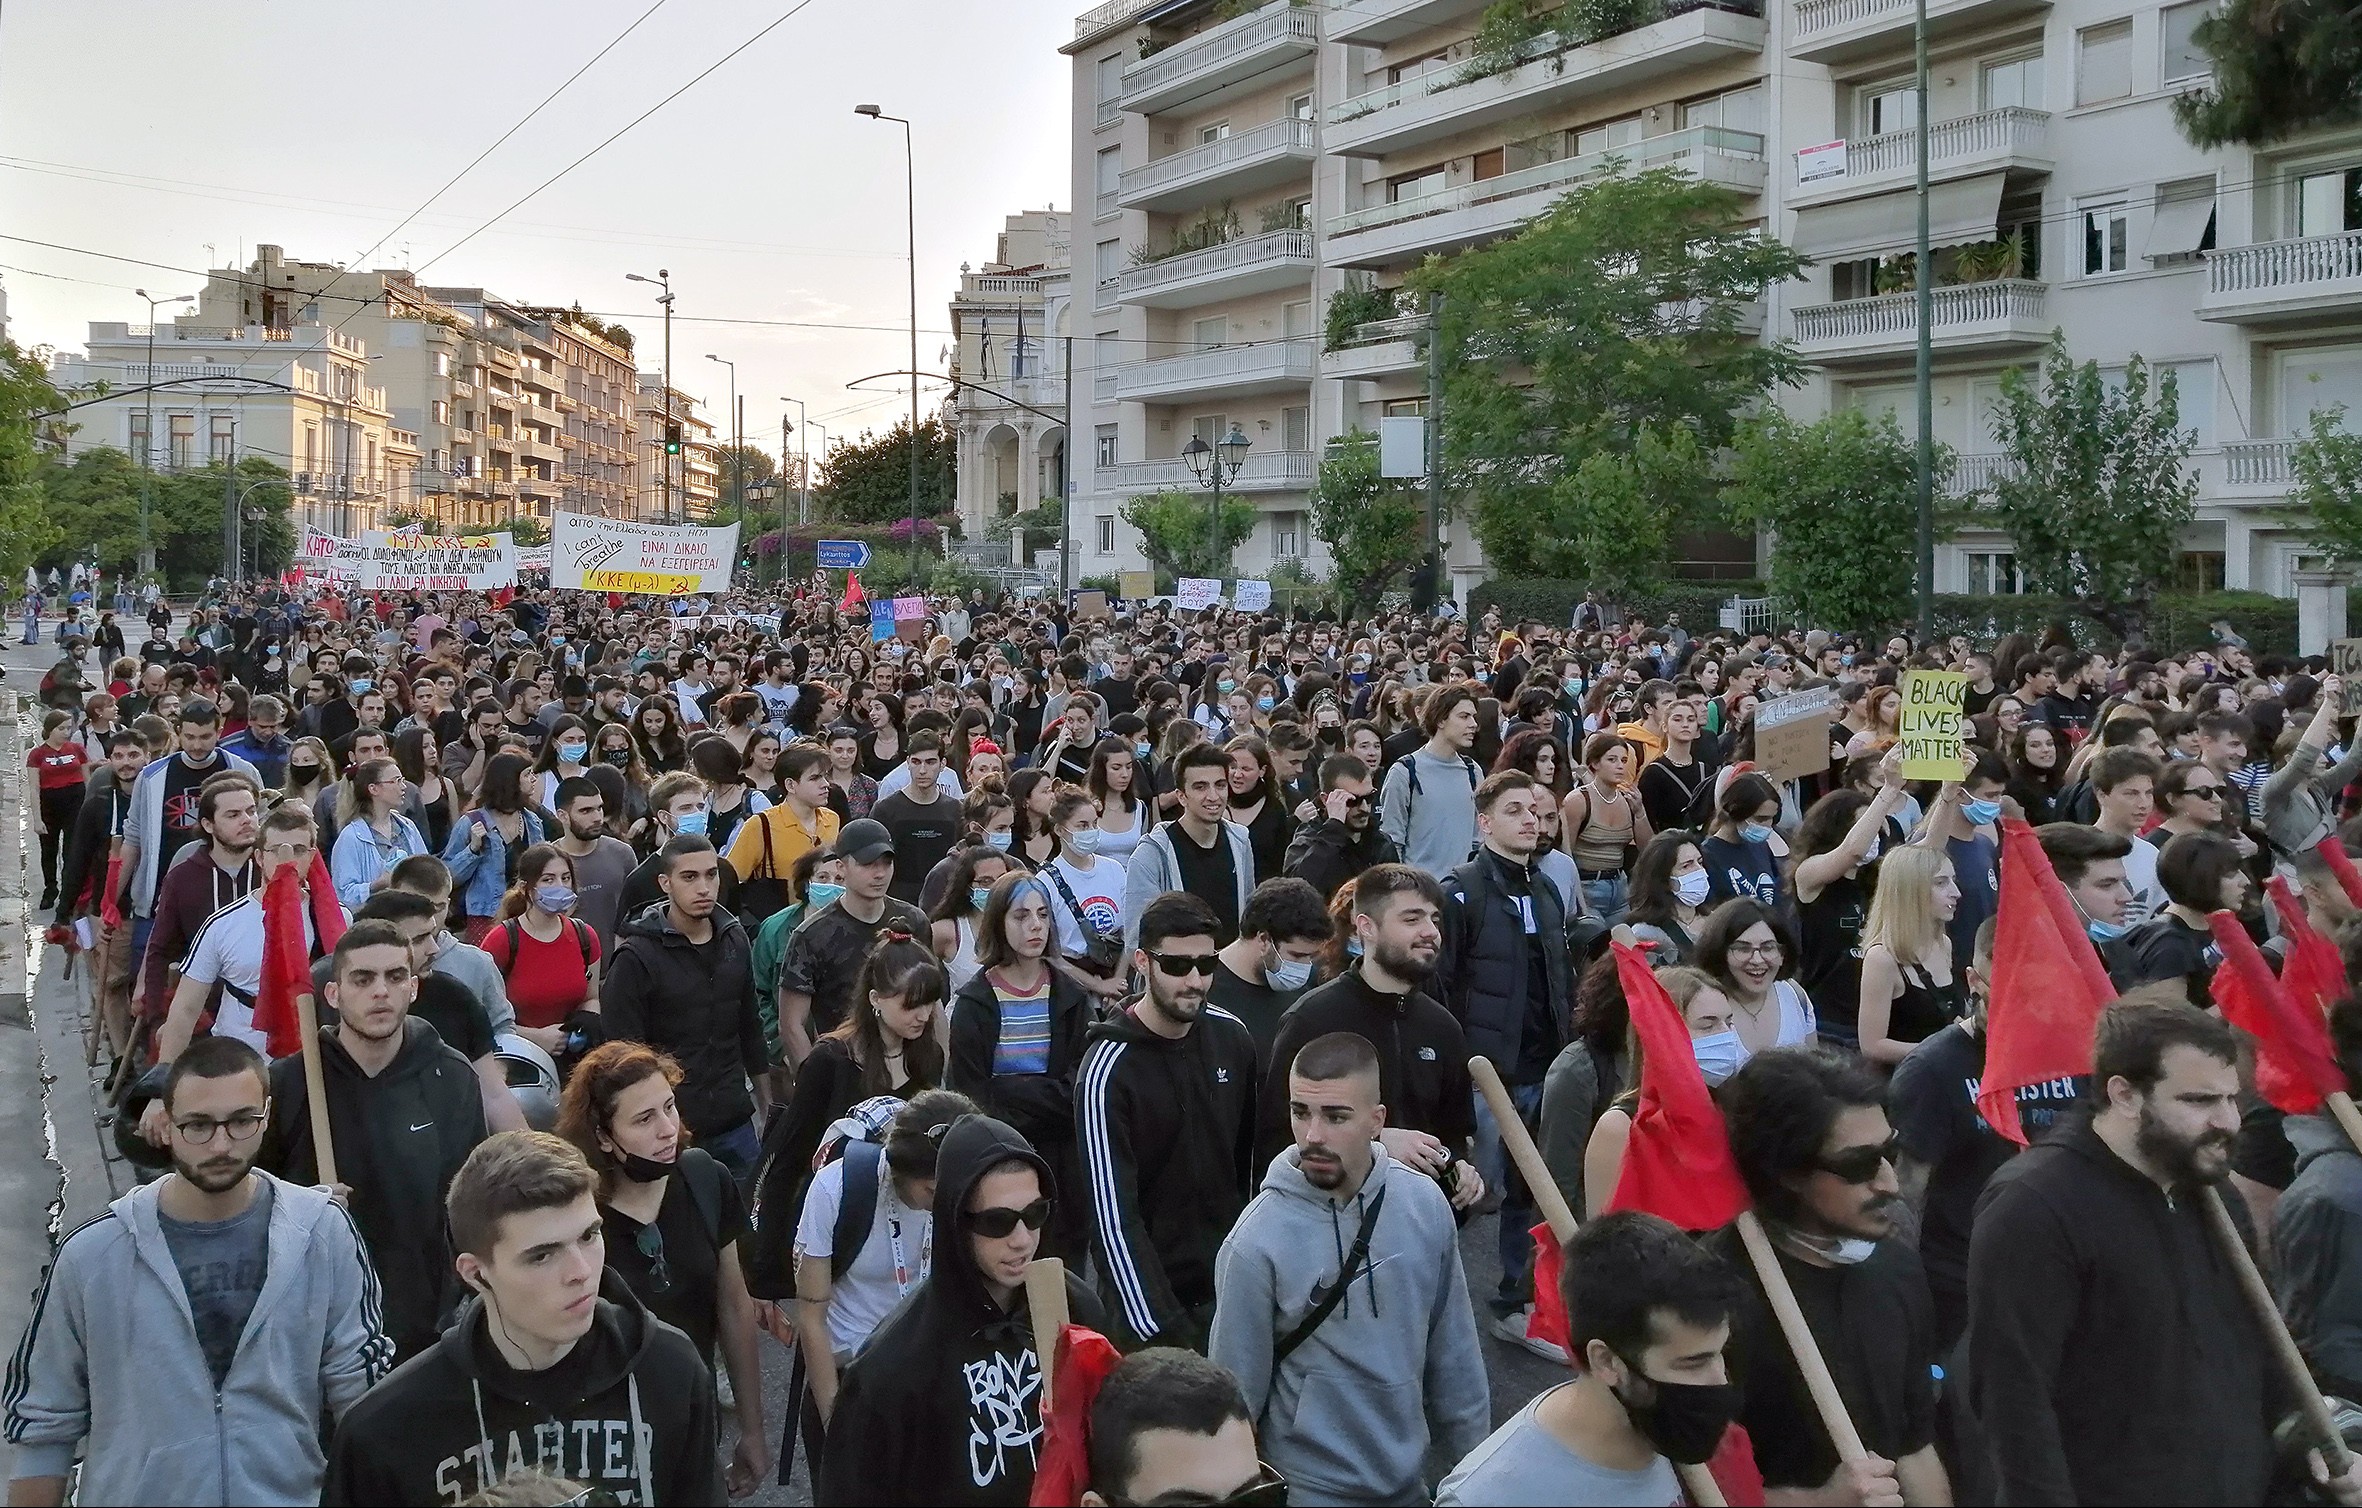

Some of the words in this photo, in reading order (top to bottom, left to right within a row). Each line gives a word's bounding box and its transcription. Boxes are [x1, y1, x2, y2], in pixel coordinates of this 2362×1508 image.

[431, 535, 469, 549] ΚΚΕ
[575, 532, 605, 552] can't
[641, 540, 669, 554] ΕΙΝΑΙ
[673, 542, 708, 556] ΔΙΚΑΙΟ
[362, 548, 370, 560] ΟΙ
[372, 548, 414, 562] ΔΟΛΟΦΟΝΟΙ
[428, 548, 445, 562] ΗΠΑ
[449, 549, 463, 562] ΔΕΝ
[468, 548, 502, 563] ΑΦΗΝΟΥΝ
[580, 538, 625, 570] breathe
[380, 562, 400, 575] ΤΟΥΣ
[404, 562, 428, 575] ΛΑΟΥΣ
[430, 562, 440, 575] ΝΑ
[442, 562, 486, 575] ΑΝΑΣΑΝΟΥΝ
[640, 556, 656, 568] ΝΑ
[661, 557, 720, 571] ΕΞΕΓΕΙΡΕΣΑΙ
[376, 576, 386, 589] ΟΙ
[390, 576, 410, 590] ΛΑΟΙ
[414, 576, 426, 590] ΘΑ
[430, 576, 468, 590] ΝΙΚΗΣΟΥΝ
[596, 572, 624, 587] ΚΚΕ
[629, 573, 660, 593] (μ-λ)
[1180, 579, 1212, 588] JUSTICE
[1180, 589, 1212, 598] GEORGE
[1180, 596, 1205, 608] FLOYD
[1237, 599, 1267, 607] MATTER
[874, 601, 894, 620] ΔΕΝ
[1910, 678, 1967, 706] BLACK
[1903, 710, 1962, 736] LIVES
[1901, 738, 1962, 760] MATTER
[1965, 1076, 2076, 1105] HISTER
